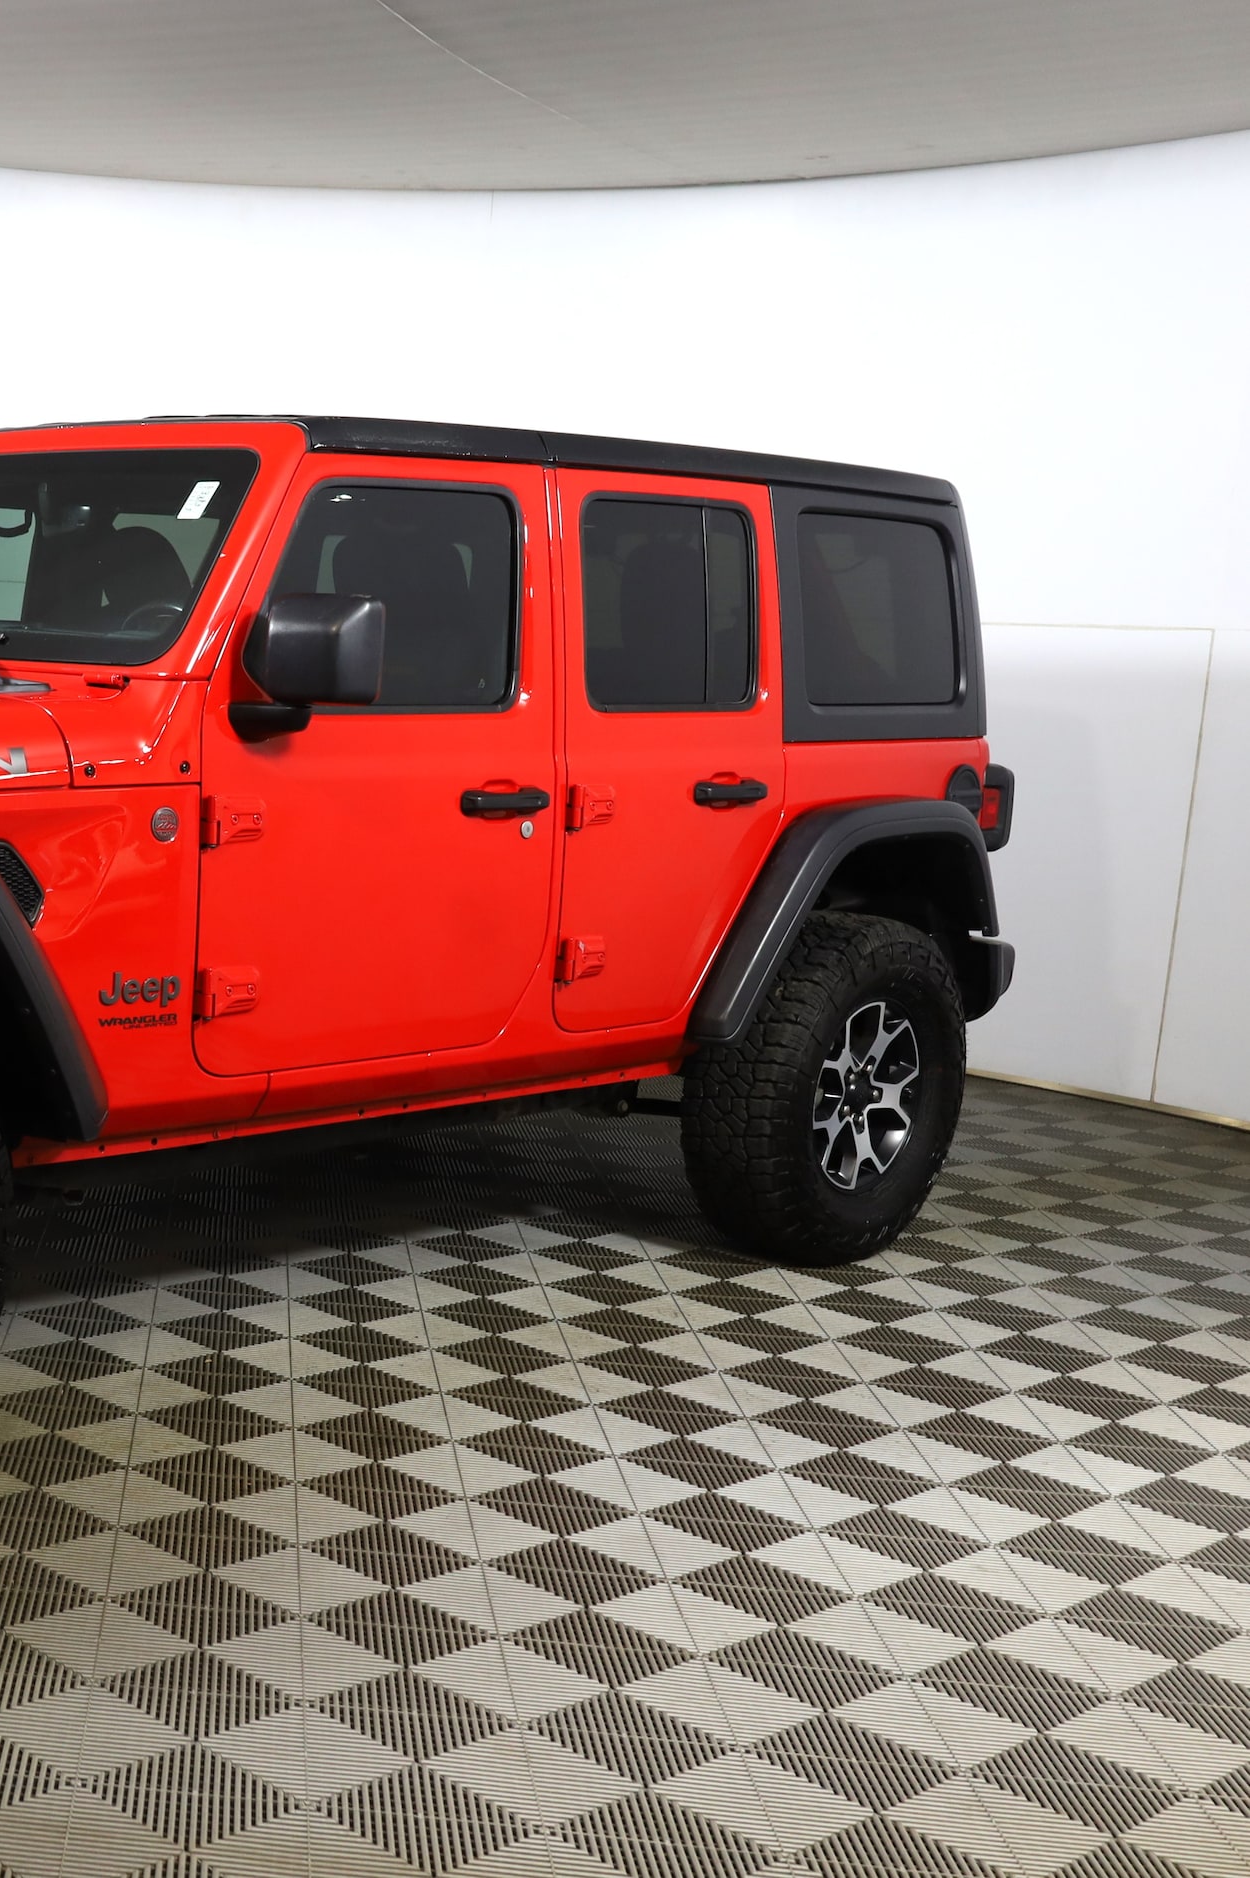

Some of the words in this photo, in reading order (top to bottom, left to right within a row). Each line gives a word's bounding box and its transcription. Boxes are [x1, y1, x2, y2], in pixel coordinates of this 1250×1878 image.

[99, 971, 181, 1008] Jeep
[98, 1013, 178, 1027] WRANGLER
[122, 1020, 178, 1029] UNLIMITED
